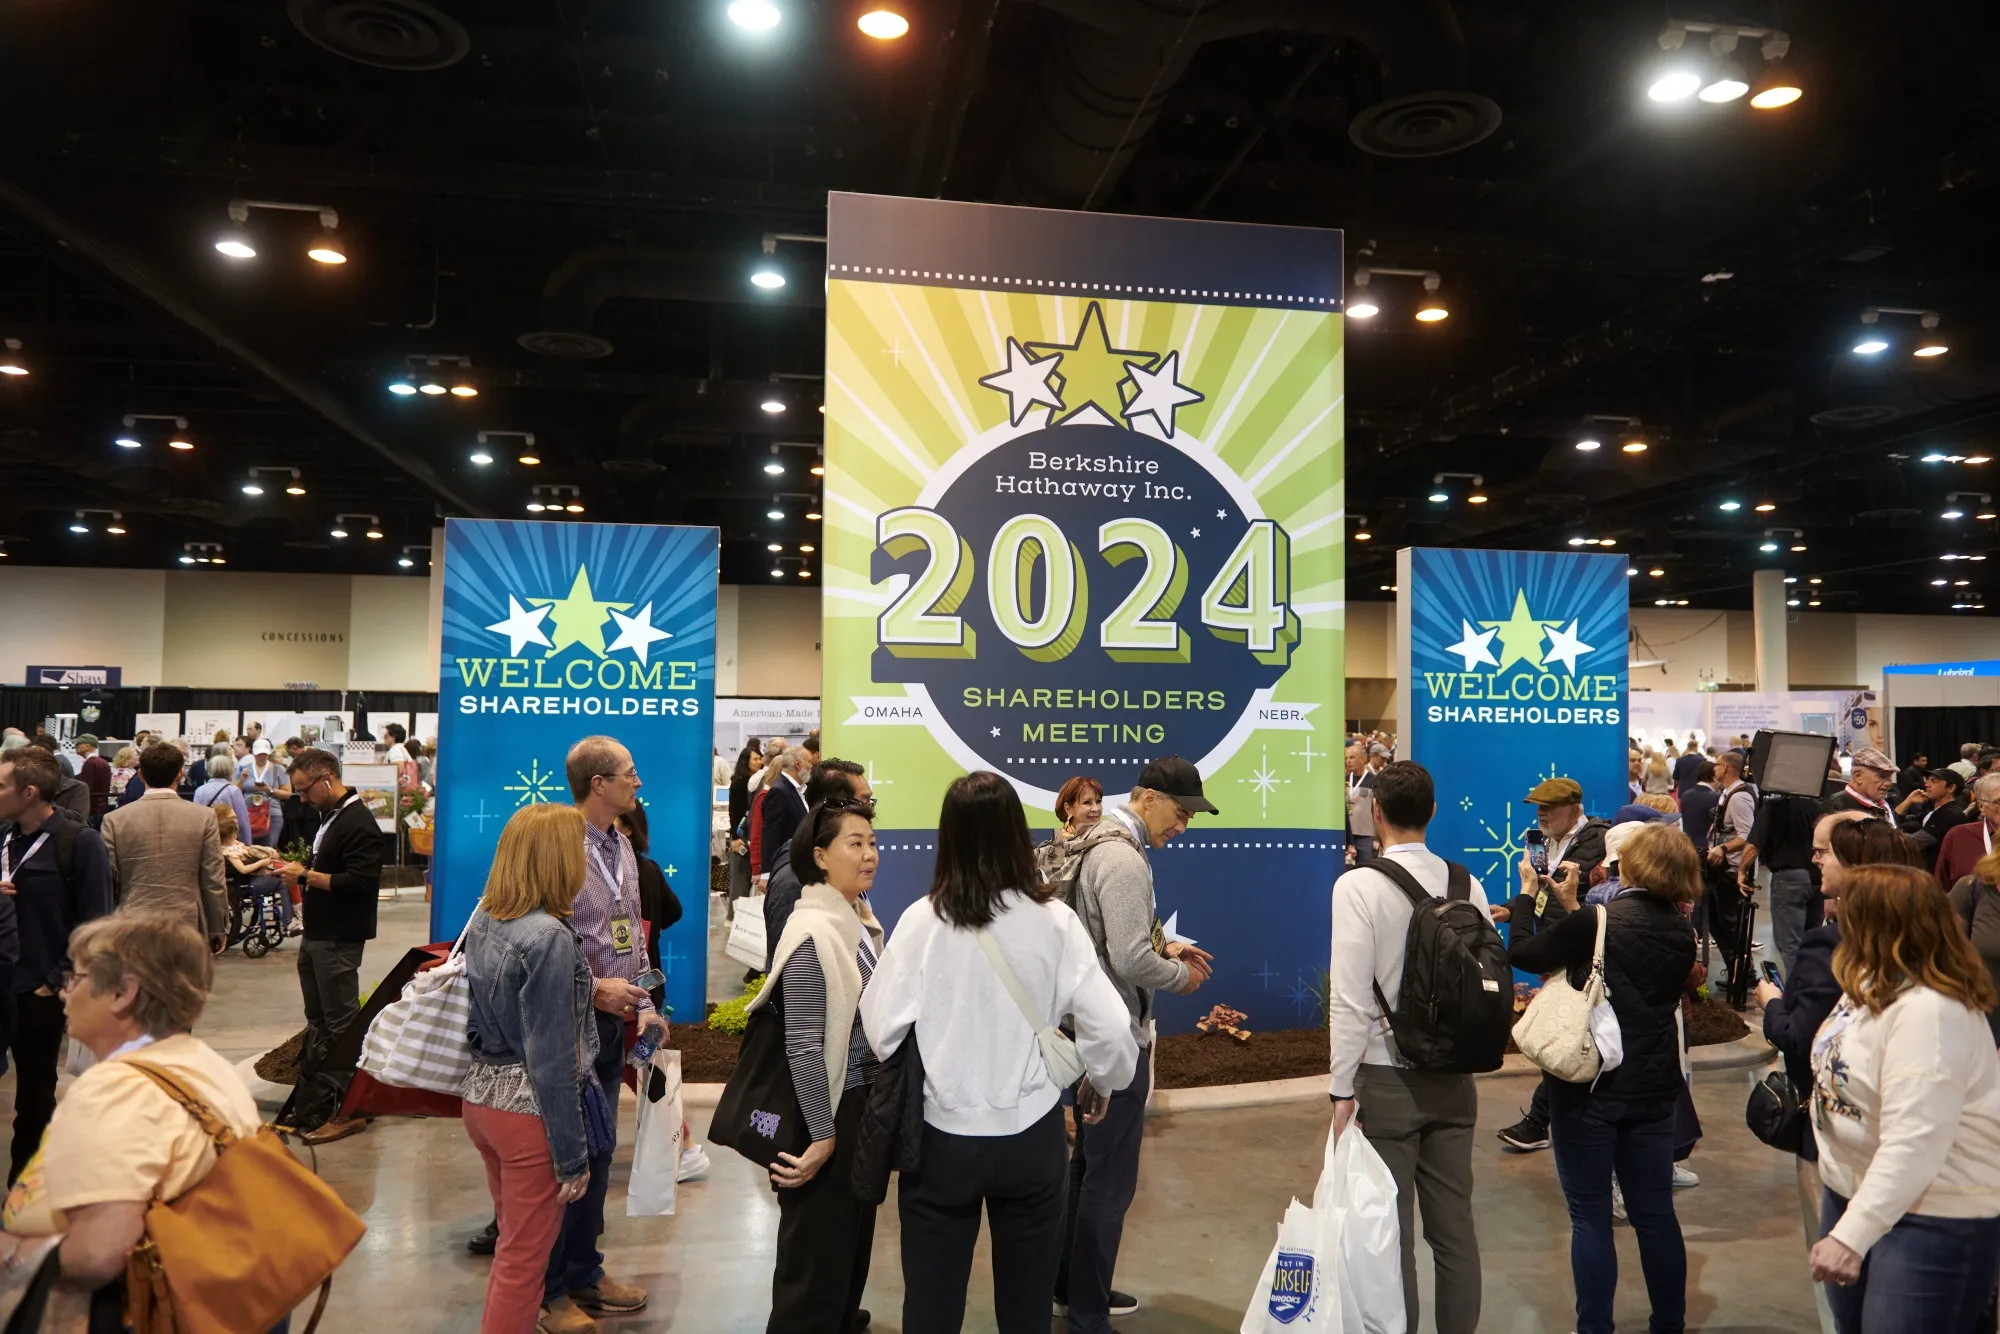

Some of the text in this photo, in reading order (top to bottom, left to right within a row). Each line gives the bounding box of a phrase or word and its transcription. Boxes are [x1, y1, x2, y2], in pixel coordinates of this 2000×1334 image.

[1028, 451, 1160, 475] Berkshire
[995, 475, 1193, 502] Hathaway Inc.
[877, 507, 1300, 665] 2024
[261, 631, 344, 643] CONCESSIONS
[66, 672, 105, 684] Shaw
[455, 658, 697, 690] WELCOME
[1424, 672, 1617, 702] WELCOME
[459, 695, 699, 716] SHAREHOLDERS
[963, 686, 1227, 711] SHAREHOLDERS
[733, 708, 813, 718] American-Made
[864, 706, 924, 719] OMAHA
[1258, 709, 1305, 721] NEBR.
[1427, 705, 1620, 725] SHAREHOLDERS
[1022, 723, 1166, 744] MEETING
[1270, 1294, 1301, 1304] BROOKS
